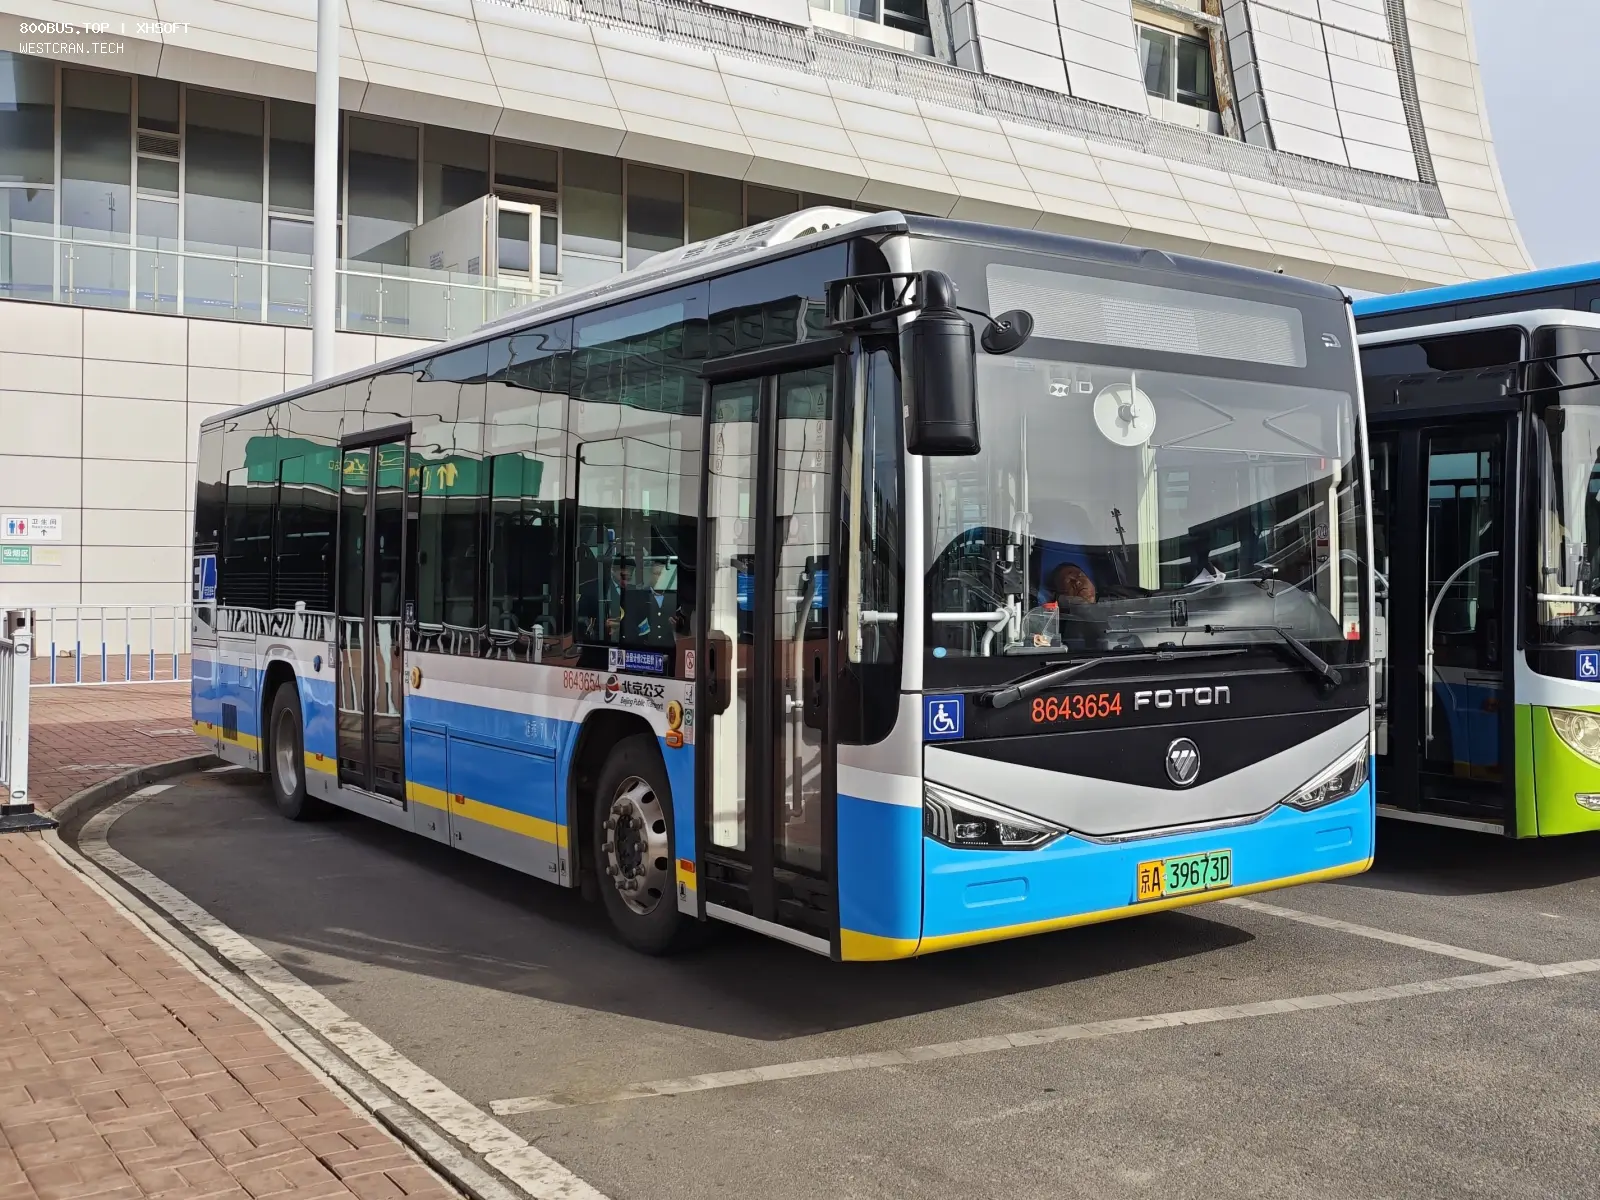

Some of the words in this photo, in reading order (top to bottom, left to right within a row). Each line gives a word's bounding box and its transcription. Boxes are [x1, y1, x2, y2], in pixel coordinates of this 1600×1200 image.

[31, 518, 57, 526] 卫生间
[563, 670, 601, 692] 8643654
[621, 680, 666, 699] 北京公交
[1031, 692, 1122, 723] 8643654
[1134, 685, 1231, 711] FOTON
